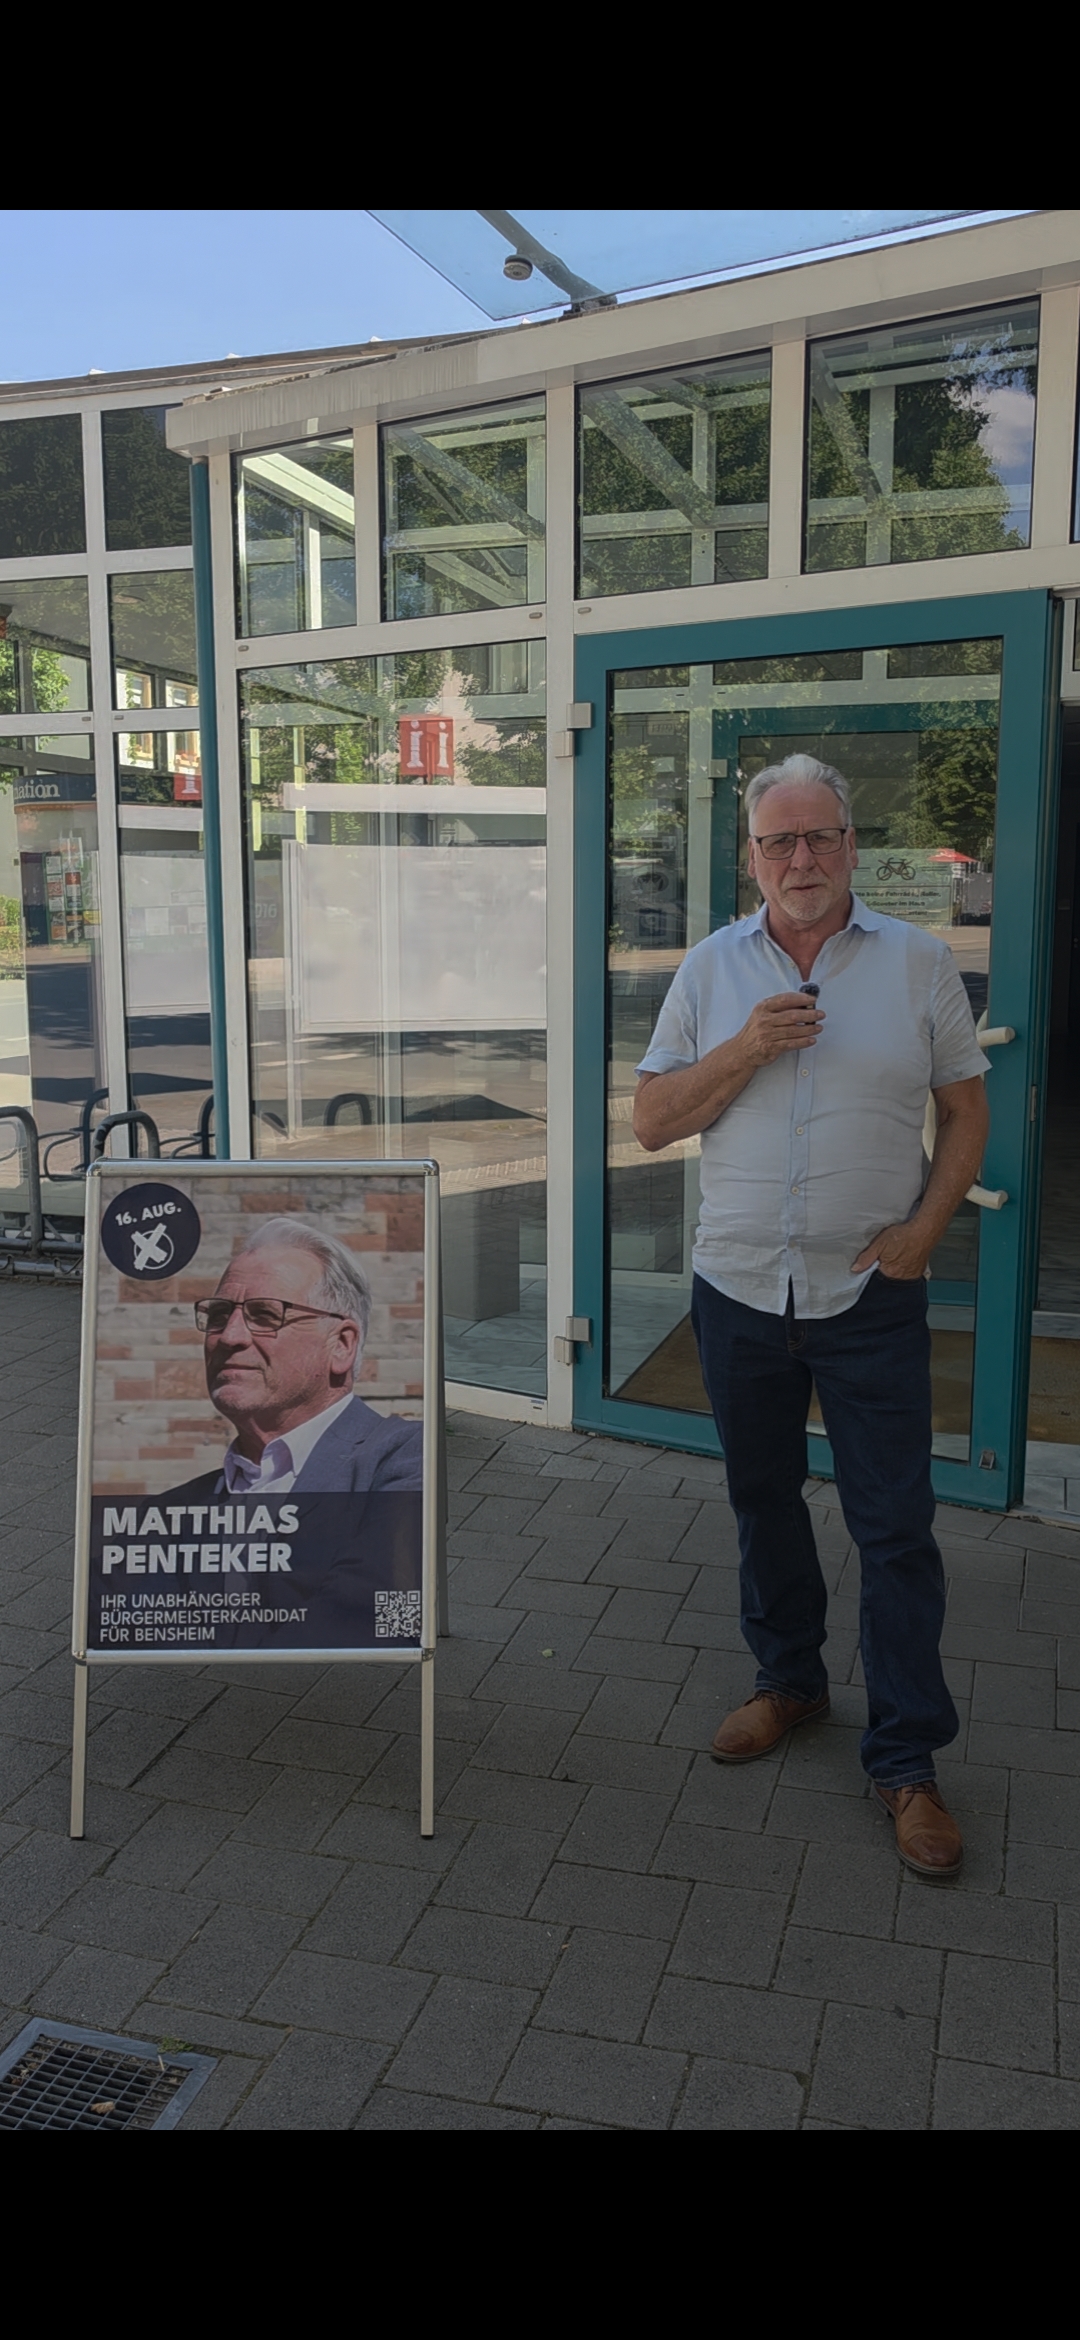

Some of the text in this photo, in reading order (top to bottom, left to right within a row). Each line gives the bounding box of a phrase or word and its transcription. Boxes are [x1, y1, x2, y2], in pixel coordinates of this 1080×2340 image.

[115, 1201, 182, 1226] 16. AUG.
[103, 1504, 299, 1536] MATTHIAS
[102, 1542, 292, 1574] PENTEKER
[101, 1590, 261, 1608] IHR UNABHÄNGIGER
[101, 1608, 308, 1625] BÜRGERMEISTERKANDIDAT
[100, 1626, 215, 1642] FÜR BENSHEIM
